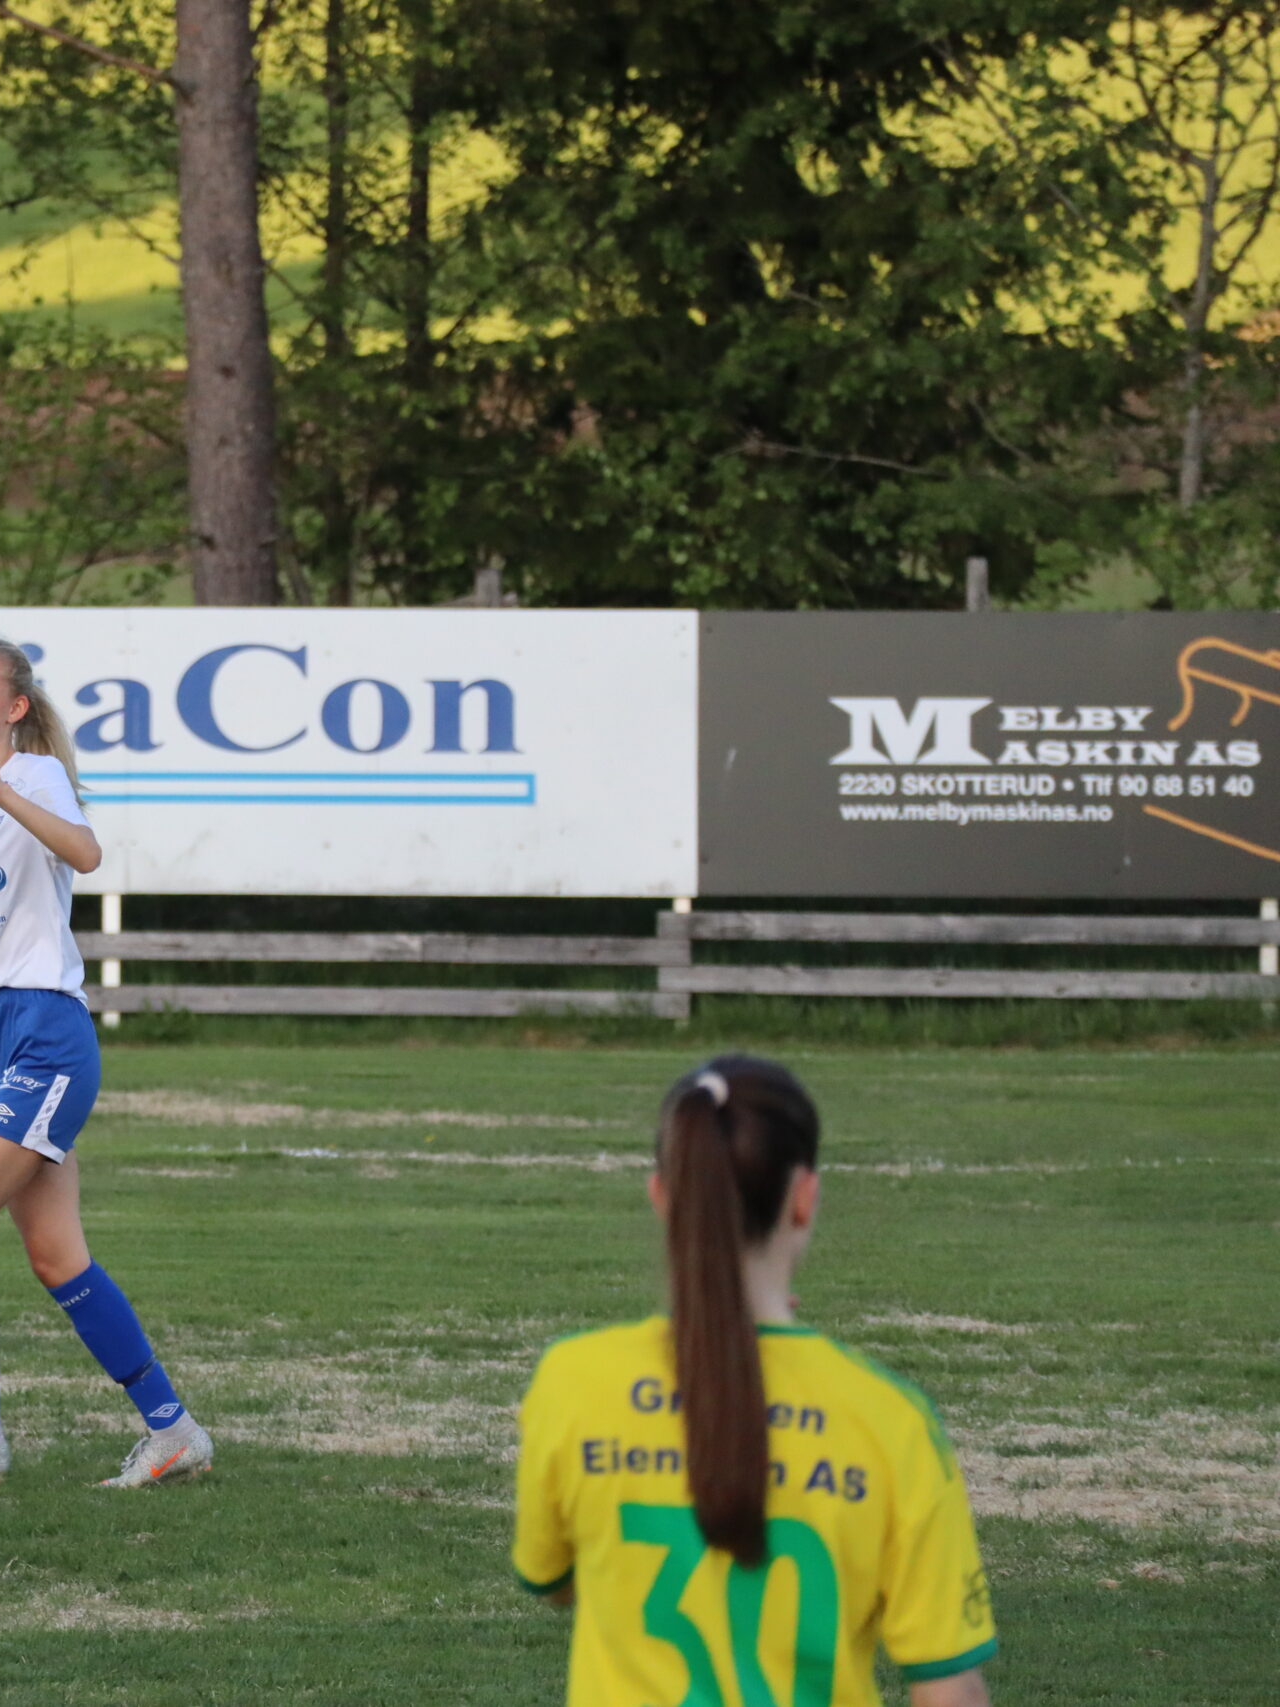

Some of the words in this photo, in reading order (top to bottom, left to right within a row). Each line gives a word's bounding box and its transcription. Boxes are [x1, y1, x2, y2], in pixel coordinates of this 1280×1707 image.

[1187, 740, 1261, 766] AS
[839, 774, 896, 796] 2230
[901, 774, 1055, 796] SKOTTERUD
[1081, 774, 1113, 796] Tlf
[1118, 775, 1148, 797] 90
[1153, 775, 1183, 797] 88
[1188, 775, 1216, 797] 51
[1223, 775, 1255, 797] 40
[839, 801, 1113, 825] www.melbymaskinas.no
[804, 1460, 867, 1503] AS
[620, 1502, 838, 1707] 30
